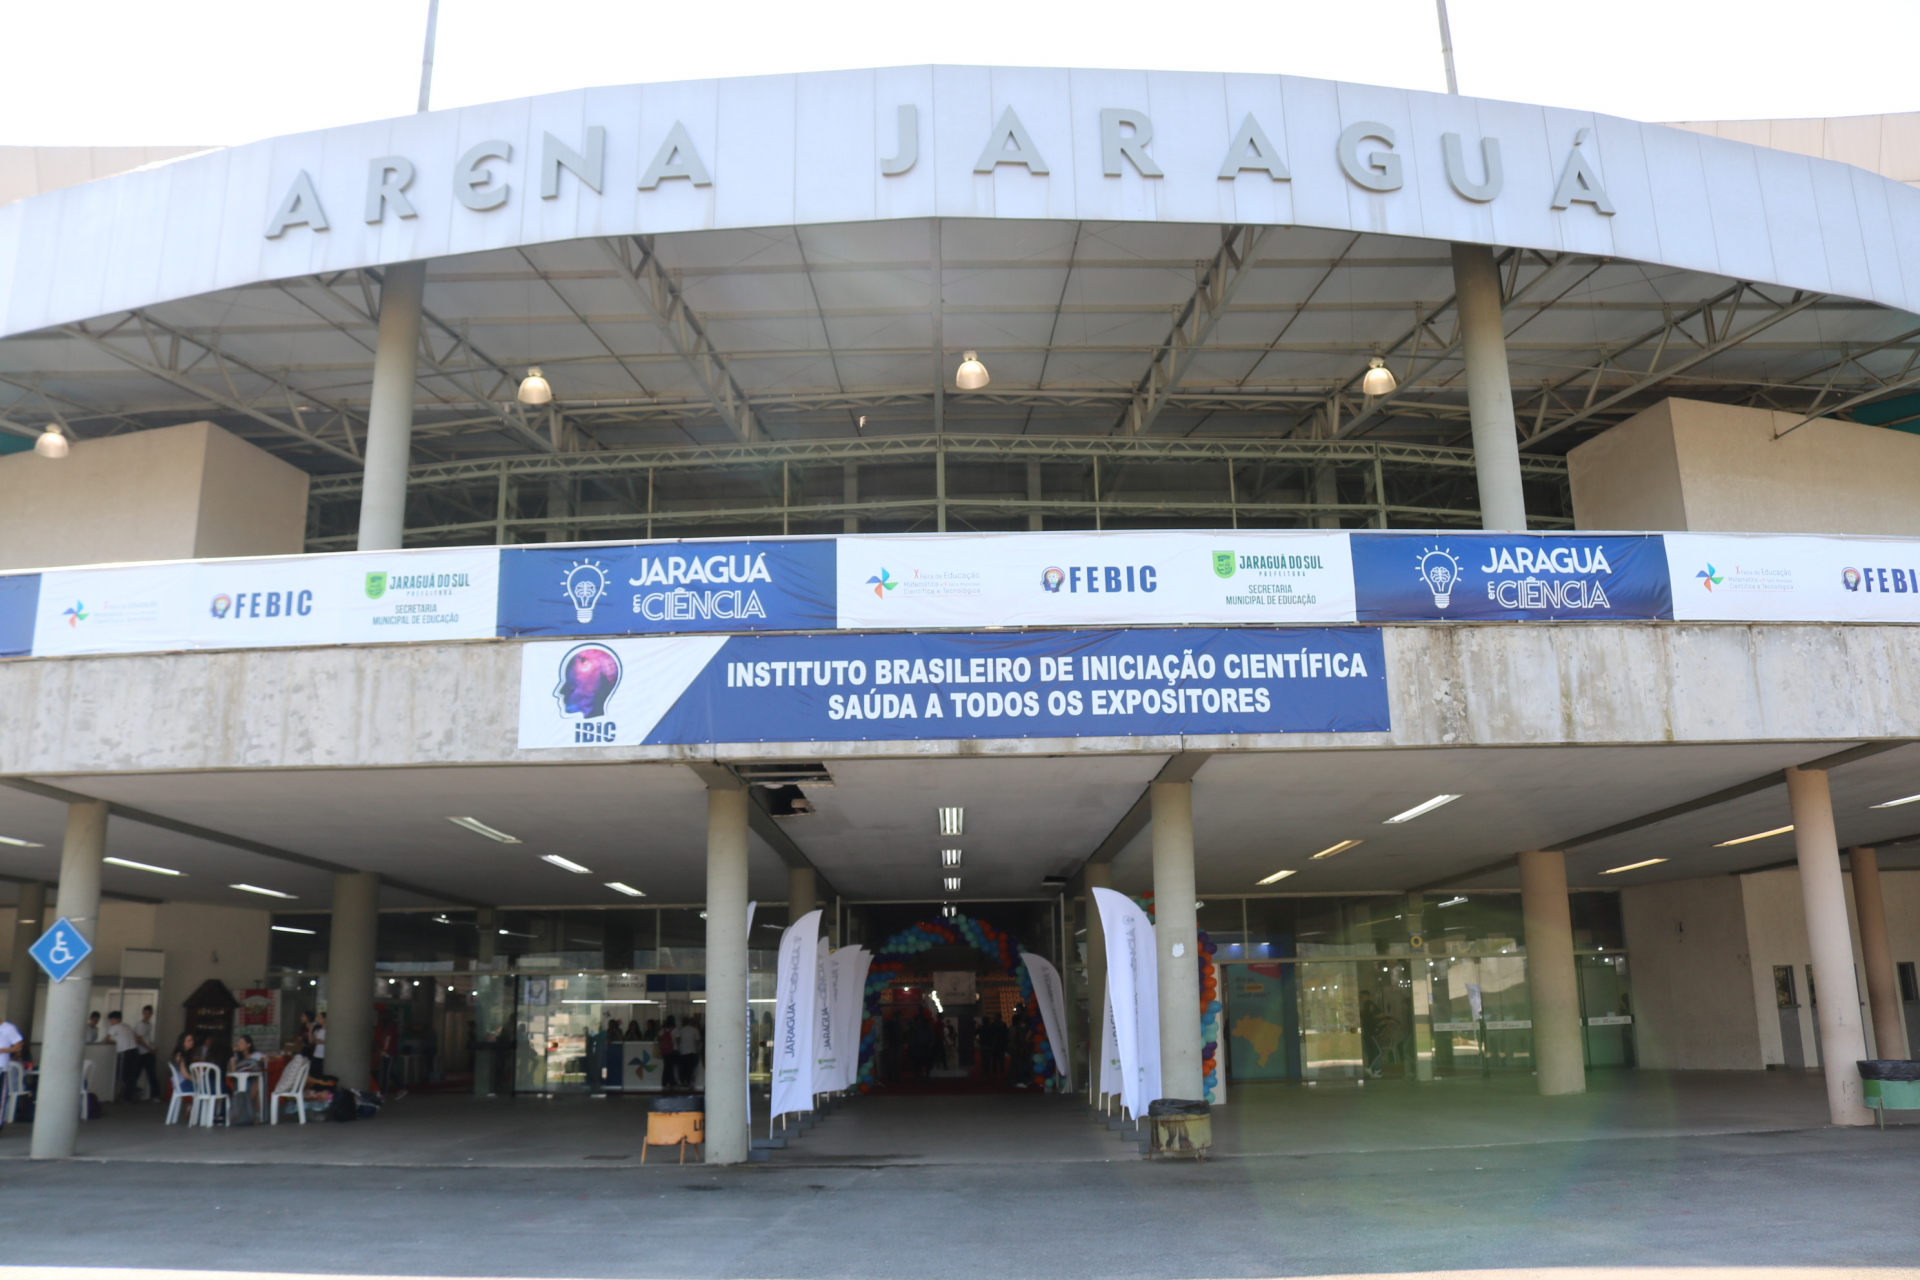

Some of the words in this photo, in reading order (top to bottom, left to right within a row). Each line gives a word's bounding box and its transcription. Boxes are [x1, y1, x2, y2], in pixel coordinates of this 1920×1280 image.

[264, 119, 713, 240] ARENA
[880, 103, 1617, 217] JARAGUÁ
[628, 552, 772, 586] JARAGUÁ
[1239, 554, 1287, 569] JARAGUÁ
[1289, 555, 1302, 569] DO
[1303, 555, 1324, 569] SUL
[1481, 545, 1612, 574] JARAGUÁ
[390, 572, 435, 590] JARAGUÁ
[437, 574, 450, 588] DO
[452, 573, 470, 588] SUL
[944, 571, 980, 580] Educação
[1069, 565, 1157, 593] FEBIC
[1761, 568, 1792, 577] Educação
[1863, 568, 1920, 593] FEBI
[904, 580, 939, 588] Matemática
[904, 587, 935, 595] Científica
[943, 588, 981, 596] Tecnológica
[1248, 584, 1293, 594] SECRETARIA
[1487, 581, 1495, 600] em
[1496, 576, 1611, 609] CIÊNCIA
[235, 589, 312, 619] FEBIC
[395, 604, 437, 614] SECRETARIA
[633, 594, 641, 613] em
[641, 587, 767, 621] CIÊNCIA
[1226, 595, 1265, 605] MUNICIPAL
[1267, 595, 1276, 605] DE
[1278, 593, 1316, 606] EDUCAÇÃO
[372, 615, 409, 625] MUNICIPAL
[411, 615, 420, 625] DE
[422, 612, 459, 624] EDUCAÇÃO
[727, 659, 867, 687] INSTITUTO
[875, 657, 1032, 685] BRASILEIRO
[1040, 656, 1074, 682] DE
[1082, 649, 1217, 686] INICIAÇÃO
[1223, 648, 1368, 679] CIENTÍFICA
[828, 688, 918, 720] SAÚDA
[924, 693, 943, 718] A
[950, 691, 1040, 718] TODOS
[1048, 690, 1083, 716] OS
[1091, 687, 1271, 715] EXPOSITORES
